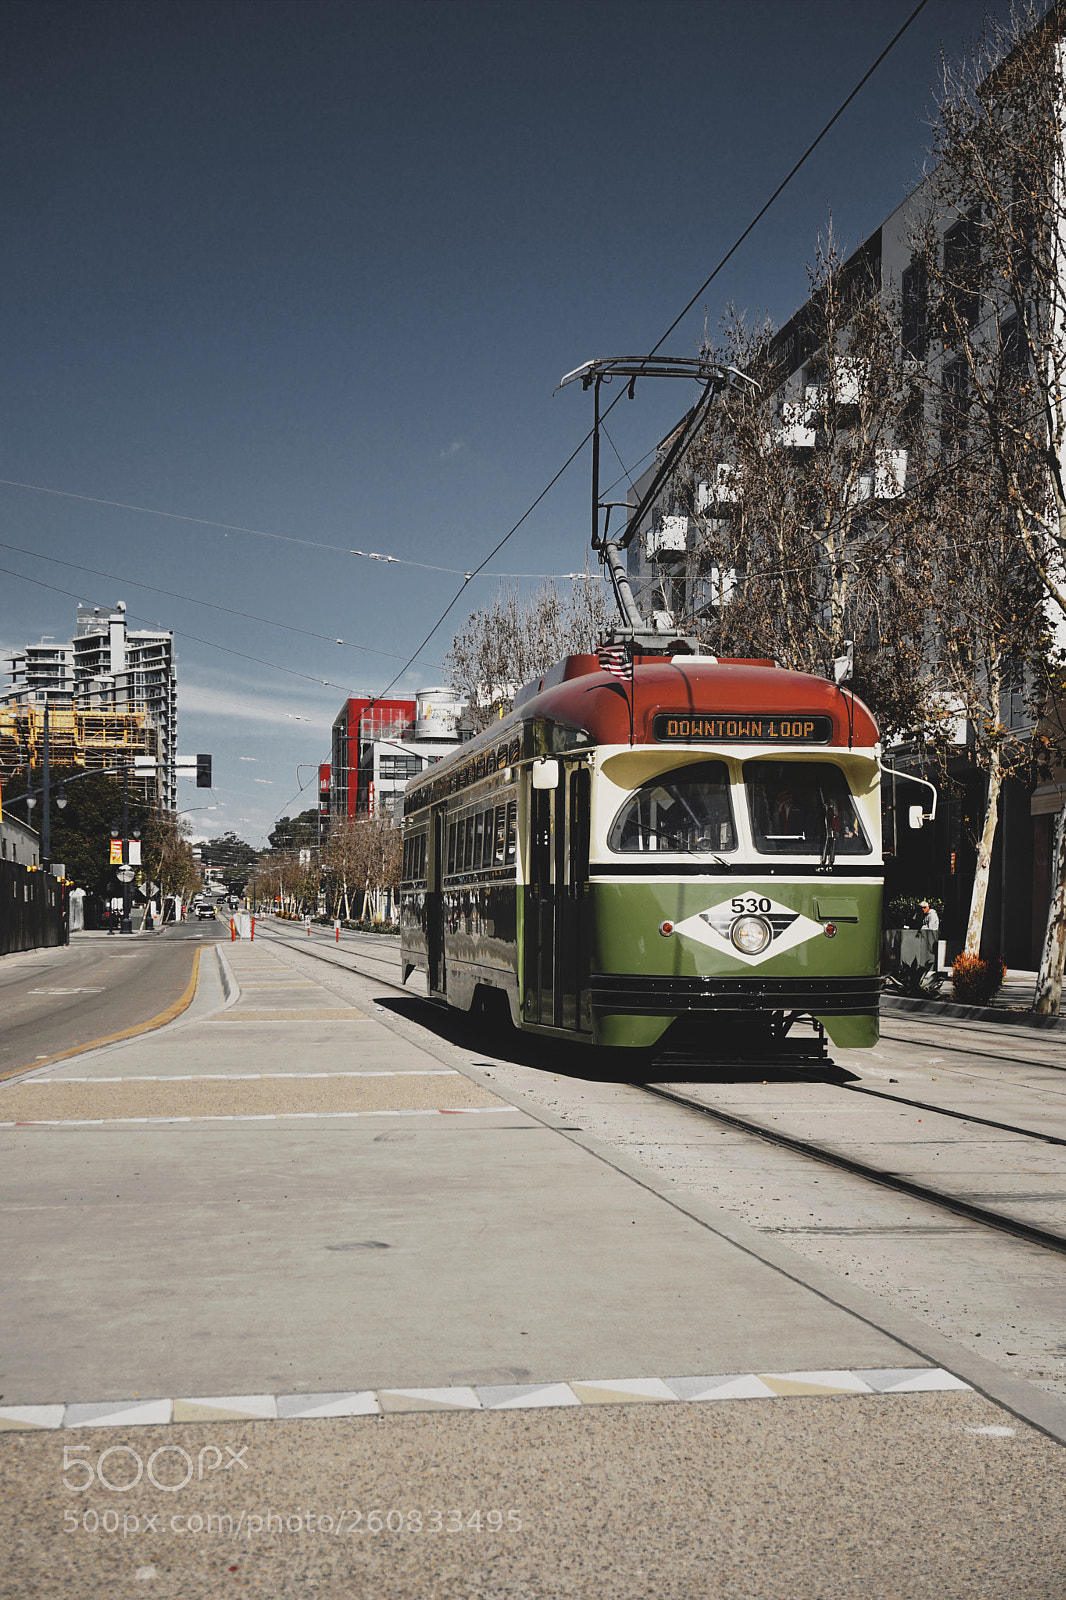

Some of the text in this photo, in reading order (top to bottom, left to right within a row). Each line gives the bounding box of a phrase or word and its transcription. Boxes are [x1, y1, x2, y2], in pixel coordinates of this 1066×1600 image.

[667, 720, 814, 737] DOWNTOWN LOOP
[731, 898, 772, 914] 530
